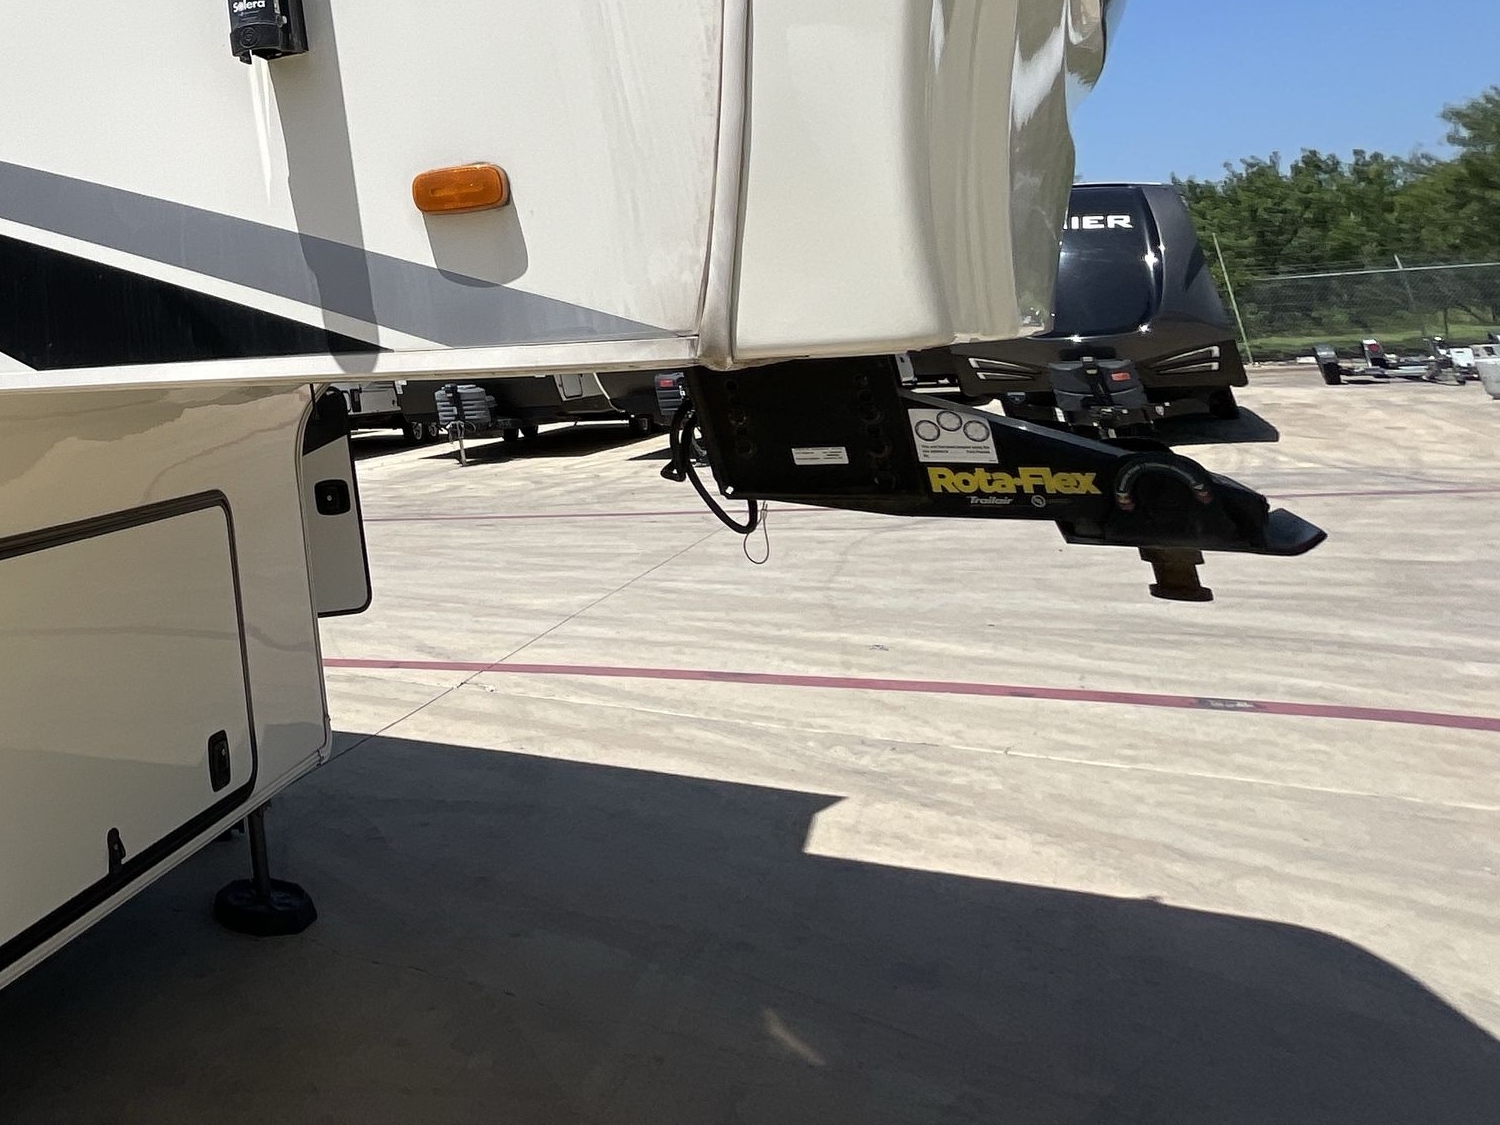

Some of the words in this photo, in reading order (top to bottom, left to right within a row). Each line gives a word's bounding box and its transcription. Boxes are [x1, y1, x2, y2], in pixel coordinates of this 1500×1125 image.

[233, 0, 266, 13] Solera
[1063, 215, 1134, 230] IER
[966, 495, 1014, 505] Trailair
